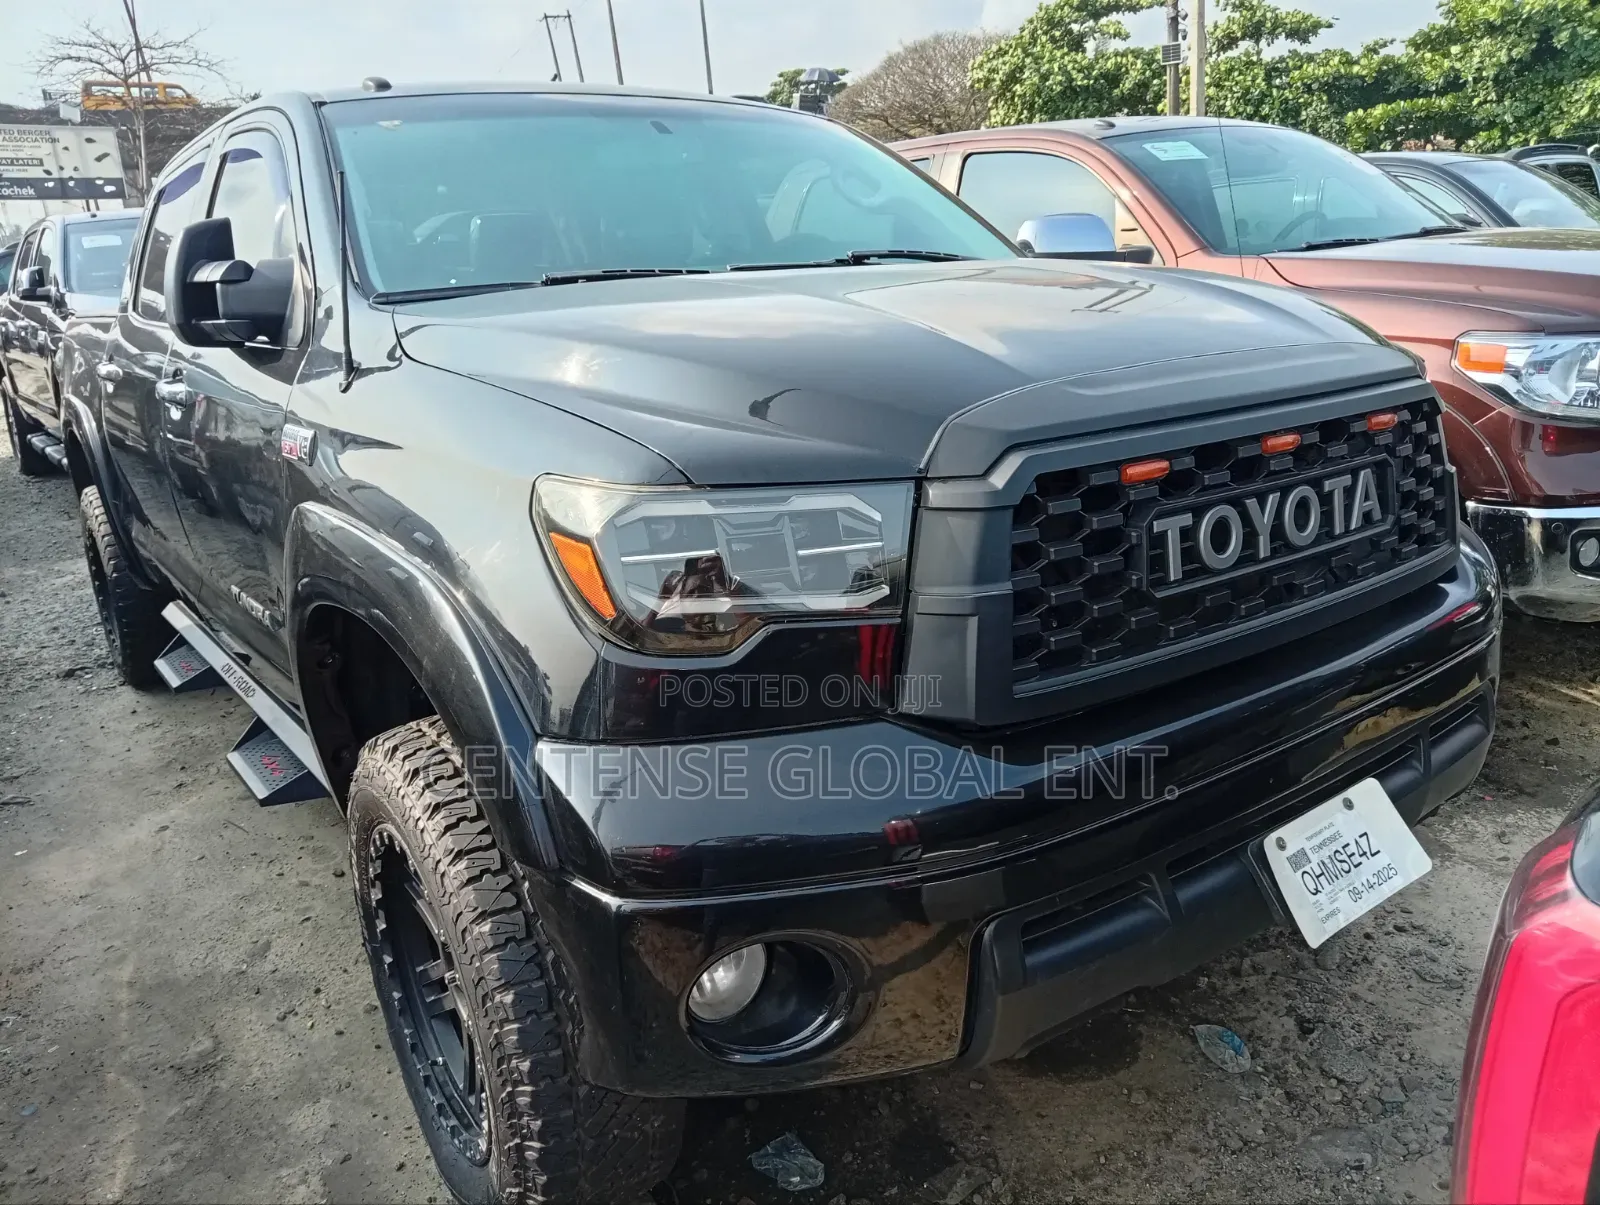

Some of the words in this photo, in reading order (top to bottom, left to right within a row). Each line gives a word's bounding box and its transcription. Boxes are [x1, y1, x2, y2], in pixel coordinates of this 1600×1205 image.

[1153, 468, 1382, 583] TOYOTA
[1301, 831, 1381, 896] QHMSE4Z
[1309, 830, 1343, 855] TENNESSEE
[1347, 863, 1398, 903] 09-14-2025
